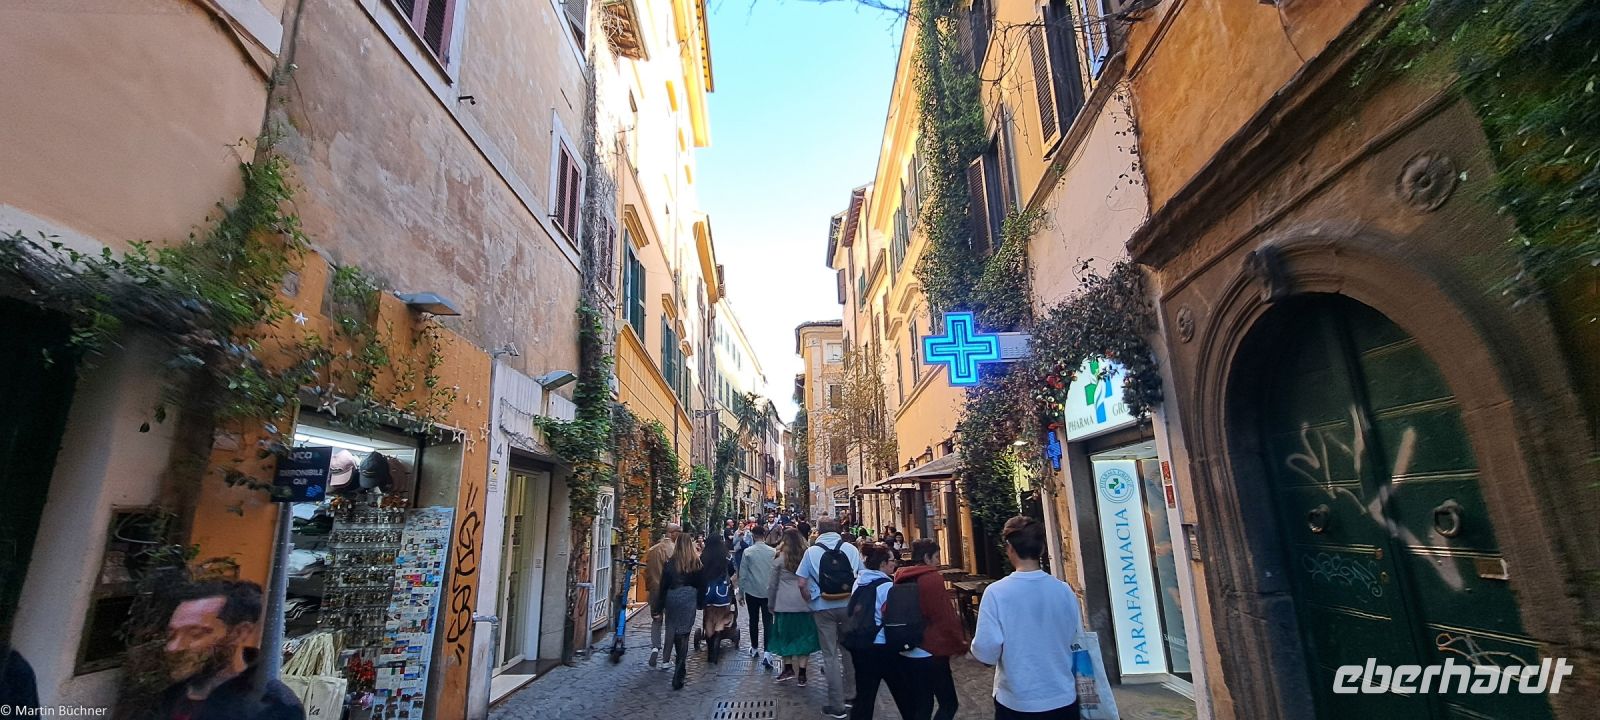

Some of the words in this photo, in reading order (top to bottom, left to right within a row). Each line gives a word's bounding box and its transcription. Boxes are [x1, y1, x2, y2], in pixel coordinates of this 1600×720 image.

[1068, 415, 1094, 432] PHARMA
[1112, 401, 1129, 417] GRO
[496, 442, 503, 458] 4
[1114, 507, 1150, 665] PARAFARMACIA
